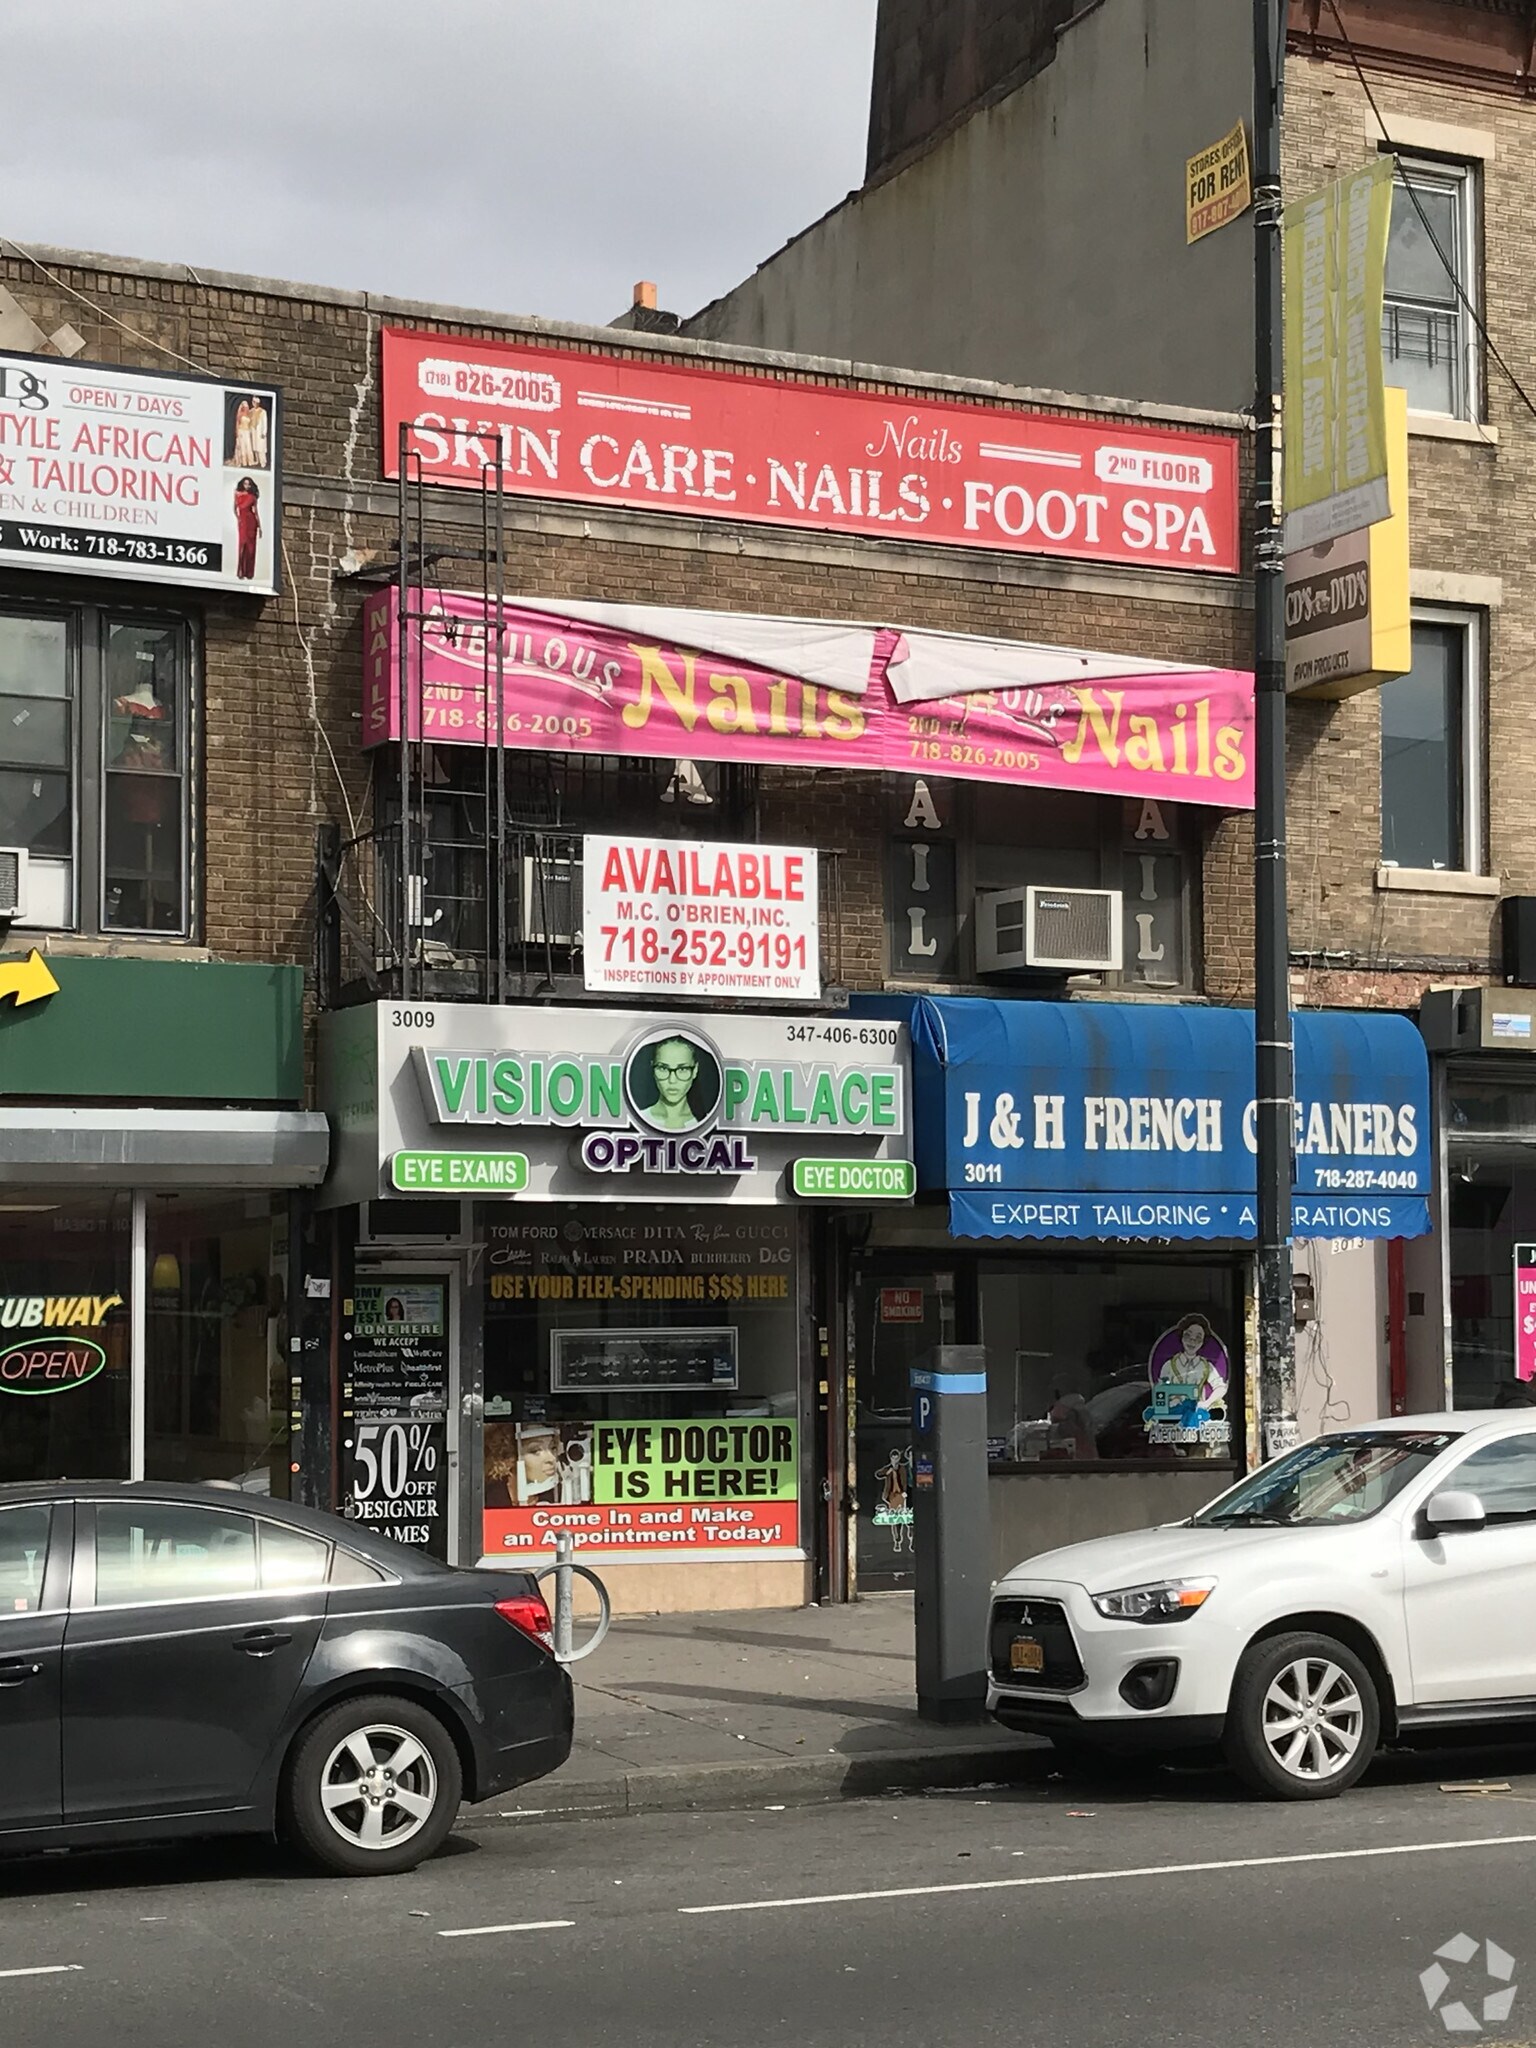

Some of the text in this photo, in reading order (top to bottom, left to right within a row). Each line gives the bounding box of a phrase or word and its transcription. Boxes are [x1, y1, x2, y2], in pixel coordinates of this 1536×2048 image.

[1190, 150, 1246, 208] FOR RENT
[454, 369, 555, 405] 826-2005
[69, 387, 184, 417] OPEN 7 DAYS
[72, 422, 212, 469] AFRICAN
[865, 415, 963, 466] Nails
[27, 456, 201, 507] TAILORING
[411, 412, 1218, 556] SKIN CARE NAILS FOOT SPA
[1142, 459, 1202, 486] FLOOR
[31, 500, 47, 515] &
[53, 499, 159, 526] CHILDREN
[18, 528, 79, 551] Work:
[85, 536, 209, 567] 718-783-1366
[1330, 569, 1367, 615] DVD'S
[369, 606, 388, 731] NAILS
[1314, 650, 1350, 677] PRODUCTS
[621, 641, 867, 741] Nails
[1061, 686, 1247, 782] Nails
[908, 740, 1041, 772] 718-826-2005
[601, 846, 805, 902] AVAILABLE
[617, 901, 660, 922] M.C.
[600, 926, 806, 971] 718-252-9191
[604, 968, 802, 990] INSPECTIONS BY APPOINTMENT ONLY
[391, 1010, 436, 1029] 3009
[786, 1025, 898, 1046] 347-406-6300
[434, 1056, 897, 1127] VISION PALACE
[963, 1092, 982, 1149] J
[990, 1092, 1025, 1150] &
[1033, 1094, 1067, 1150] H
[1083, 1096, 1224, 1154] FRENCH
[584, 1136, 756, 1171] OPTICAL
[404, 1159, 518, 1185] EYE EXAMS
[803, 1166, 906, 1191] EYE DOCTOR
[964, 1162, 1003, 1184] 3011
[1313, 1167, 1419, 1190] 718-287-4040
[991, 1204, 1393, 1228] EXPERT TAILORING ARATIONS
[491, 1226, 559, 1239] TOM FORD
[582, 1226, 637, 1240] VERSACE
[643, 1226, 687, 1240] DITA
[1333, 1238, 1366, 1254] 3013
[622, 1249, 685, 1265] PRADA
[758, 1247, 793, 1265] D&G
[490, 1273, 789, 1301] USE YOUR FLEX-SPENDING $$$ HERE
[893, 1289, 911, 1304] NO
[0, 1294, 123, 1329] UBWAY
[356, 1300, 378, 1311] EYE
[882, 1305, 922, 1318] SMOKING
[354, 1324, 441, 1335] DONE HERE
[373, 1337, 419, 1346] WE ACCEPT
[1, 1351, 90, 1380] OPEN
[920, 1396, 931, 1428] P
[599, 1424, 793, 1466] EYE DOCTOR
[354, 1424, 437, 1500] 50%
[404, 1480, 438, 1496] OFF
[614, 1468, 780, 1498] IS HERE!
[531, 1506, 755, 1528] Come In and Make
[503, 1531, 534, 1547] an
[703, 1524, 782, 1545] Today!
